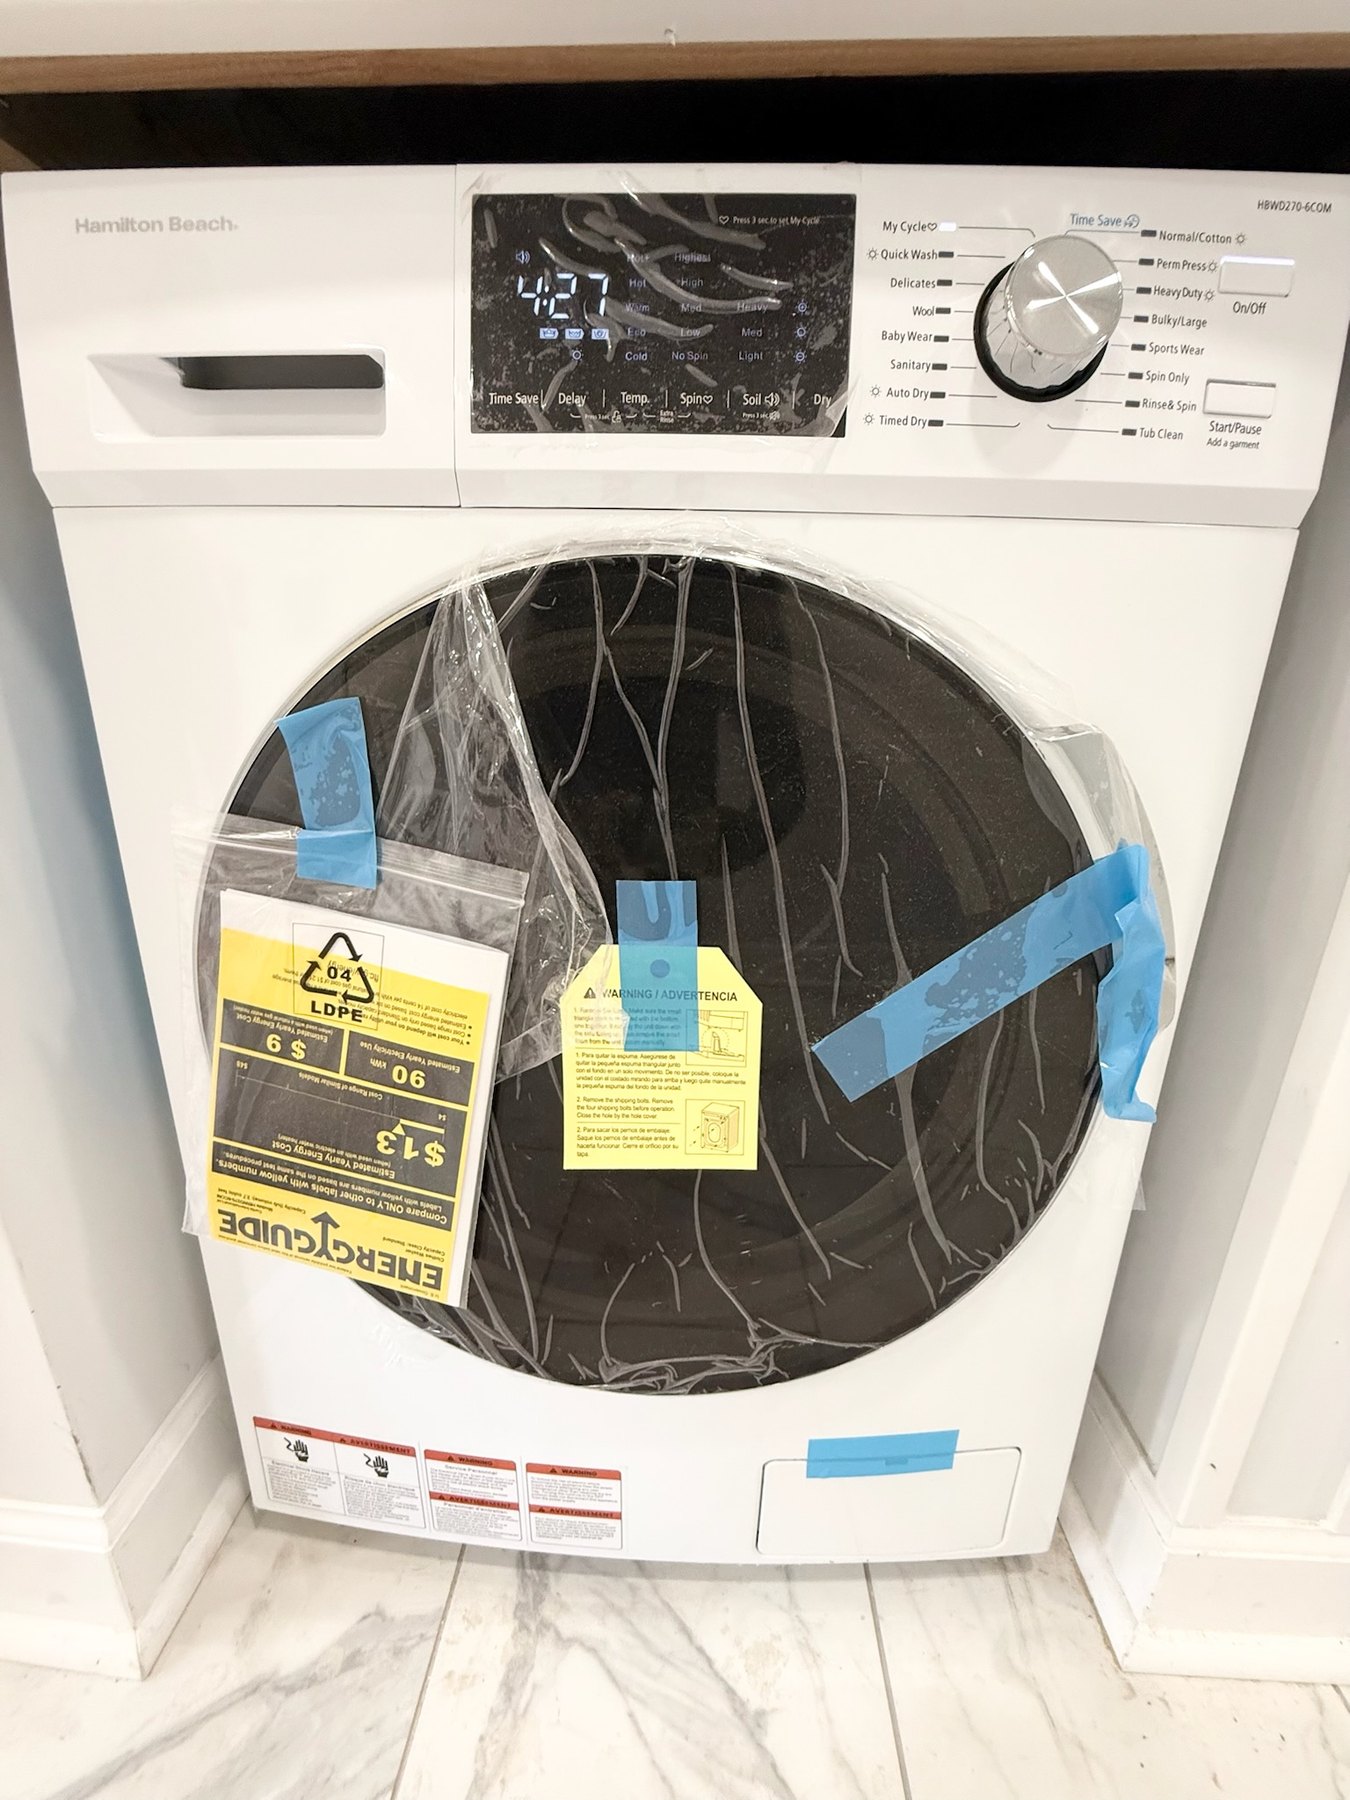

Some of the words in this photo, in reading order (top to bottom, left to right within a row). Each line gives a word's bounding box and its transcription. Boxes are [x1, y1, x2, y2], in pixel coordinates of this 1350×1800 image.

[1257, 200, 1332, 213] HBWD270-6COM
[75, 217, 164, 234] Hamilton
[733, 216, 750, 224] Press
[790, 216, 800, 226] My
[1070, 213, 1095, 226] Time
[1098, 215, 1122, 227] Save
[883, 221, 898, 234] My
[900, 221, 927, 234] Cycle
[1159, 230, 1232, 244] Normal/Cotton
[675, 252, 711, 264] Highest
[881, 248, 909, 261] Quick
[911, 249, 938, 260] Wash
[1157, 258, 1180, 270] Perm
[1182, 259, 1207, 272] Press
[629, 279, 646, 287] Hot
[681, 278, 703, 288] High
[890, 277, 936, 288] Delicates
[517, 273, 609, 319] 4:27
[1153, 285, 1182, 300] Heavy
[1182, 287, 1203, 301] Duty
[626, 304, 649, 312] Warm
[681, 304, 702, 312] Med
[737, 303, 768, 314] Heavy
[912, 306, 935, 316] Wool
[1233, 301, 1267, 315] On/Off
[1152, 314, 1208, 330] Bulky/Large
[681, 328, 701, 337] Low
[742, 328, 762, 337] Med
[881, 330, 906, 343] Baby
[907, 331, 933, 342] Wear
[1148, 341, 1178, 355] Sports
[1180, 344, 1204, 356] Wear
[625, 352, 648, 361] Cold
[672, 352, 684, 361] No
[687, 352, 709, 362] Spin
[739, 351, 763, 362] Light
[890, 359, 931, 373] Sanitary
[1146, 370, 1166, 383] Spin
[1168, 371, 1190, 386] Only
[489, 391, 512, 405] Time
[515, 391, 539, 405] Save
[558, 392, 587, 407] Delay
[620, 391, 650, 407] Temp.
[680, 392, 702, 407] Spin
[743, 392, 762, 406] Soil
[813, 393, 832, 408] Dry
[886, 387, 910, 398] Auto
[912, 387, 930, 401] Dry
[1176, 400, 1197, 414] Spin
[880, 414, 909, 426] Timed
[911, 415, 927, 430] Dry
[1209, 420, 1262, 436] Start/Pause
[1139, 427, 1156, 439] Tub
[1157, 428, 1184, 440] Clean
[1206, 437, 1222, 447] Add
[1229, 440, 1260, 451] garment
[327, 966, 352, 982] 04
[661, 990, 738, 1001] ADVERTENCIA
[235, 1011, 252, 1023] Cost
[311, 1000, 363, 1023] LDPE
[251, 1014, 275, 1029] Energy
[274, 1020, 296, 1035] Yearly
[295, 1026, 328, 1043] Estimated
[358, 1039, 372, 1051] Use
[371, 1042, 405, 1060] Electricity
[368, 1056, 387, 1070] kWh
[405, 1051, 427, 1065] Yearly
[426, 1057, 461, 1074] Estimated
[297, 1070, 320, 1084] Models
[319, 1077, 341, 1090] Similar
[392, 1064, 425, 1089] 90
[340, 1083, 348, 1091] of
[348, 1083, 368, 1096] Range
[367, 1089, 383, 1101] Cost
[437, 1111, 447, 1122] $4
[270, 1139, 292, 1153] Cost
[297, 1138, 314, 1148] water
[314, 1142, 336, 1154] electric
[376, 1130, 446, 1167] $13
[222, 1149, 262, 1167] procedures.
[292, 1143, 323, 1161] Energy
[343, 1150, 357, 1159] with
[357, 1153, 372, 1163] used
[261, 1161, 276, 1171] test
[323, 1151, 352, 1168] Yearly
[214, 1157, 258, 1177] numbers.
[275, 1164, 294, 1175] same
[294, 1169, 306, 1178] the
[351, 1160, 396, 1179] Estimated
[258, 1167, 288, 1185] yellow
[289, 1176, 309, 1190] with
[306, 1172, 317, 1180] on
[316, 1175, 338, 1187] based
[310, 1182, 338, 1197] labels
[338, 1180, 350, 1189] are
[350, 1183, 380, 1197] numbers
[338, 1189, 364, 1204] other
[364, 1195, 375, 1207] to
[379, 1189, 403, 1203] yellow
[403, 1196, 419, 1207] with
[376, 1198, 404, 1214] ONLY
[418, 1200, 442, 1213] Labels
[404, 1204, 448, 1225] Compare
[561, 1468, 598, 1477] WARNING
